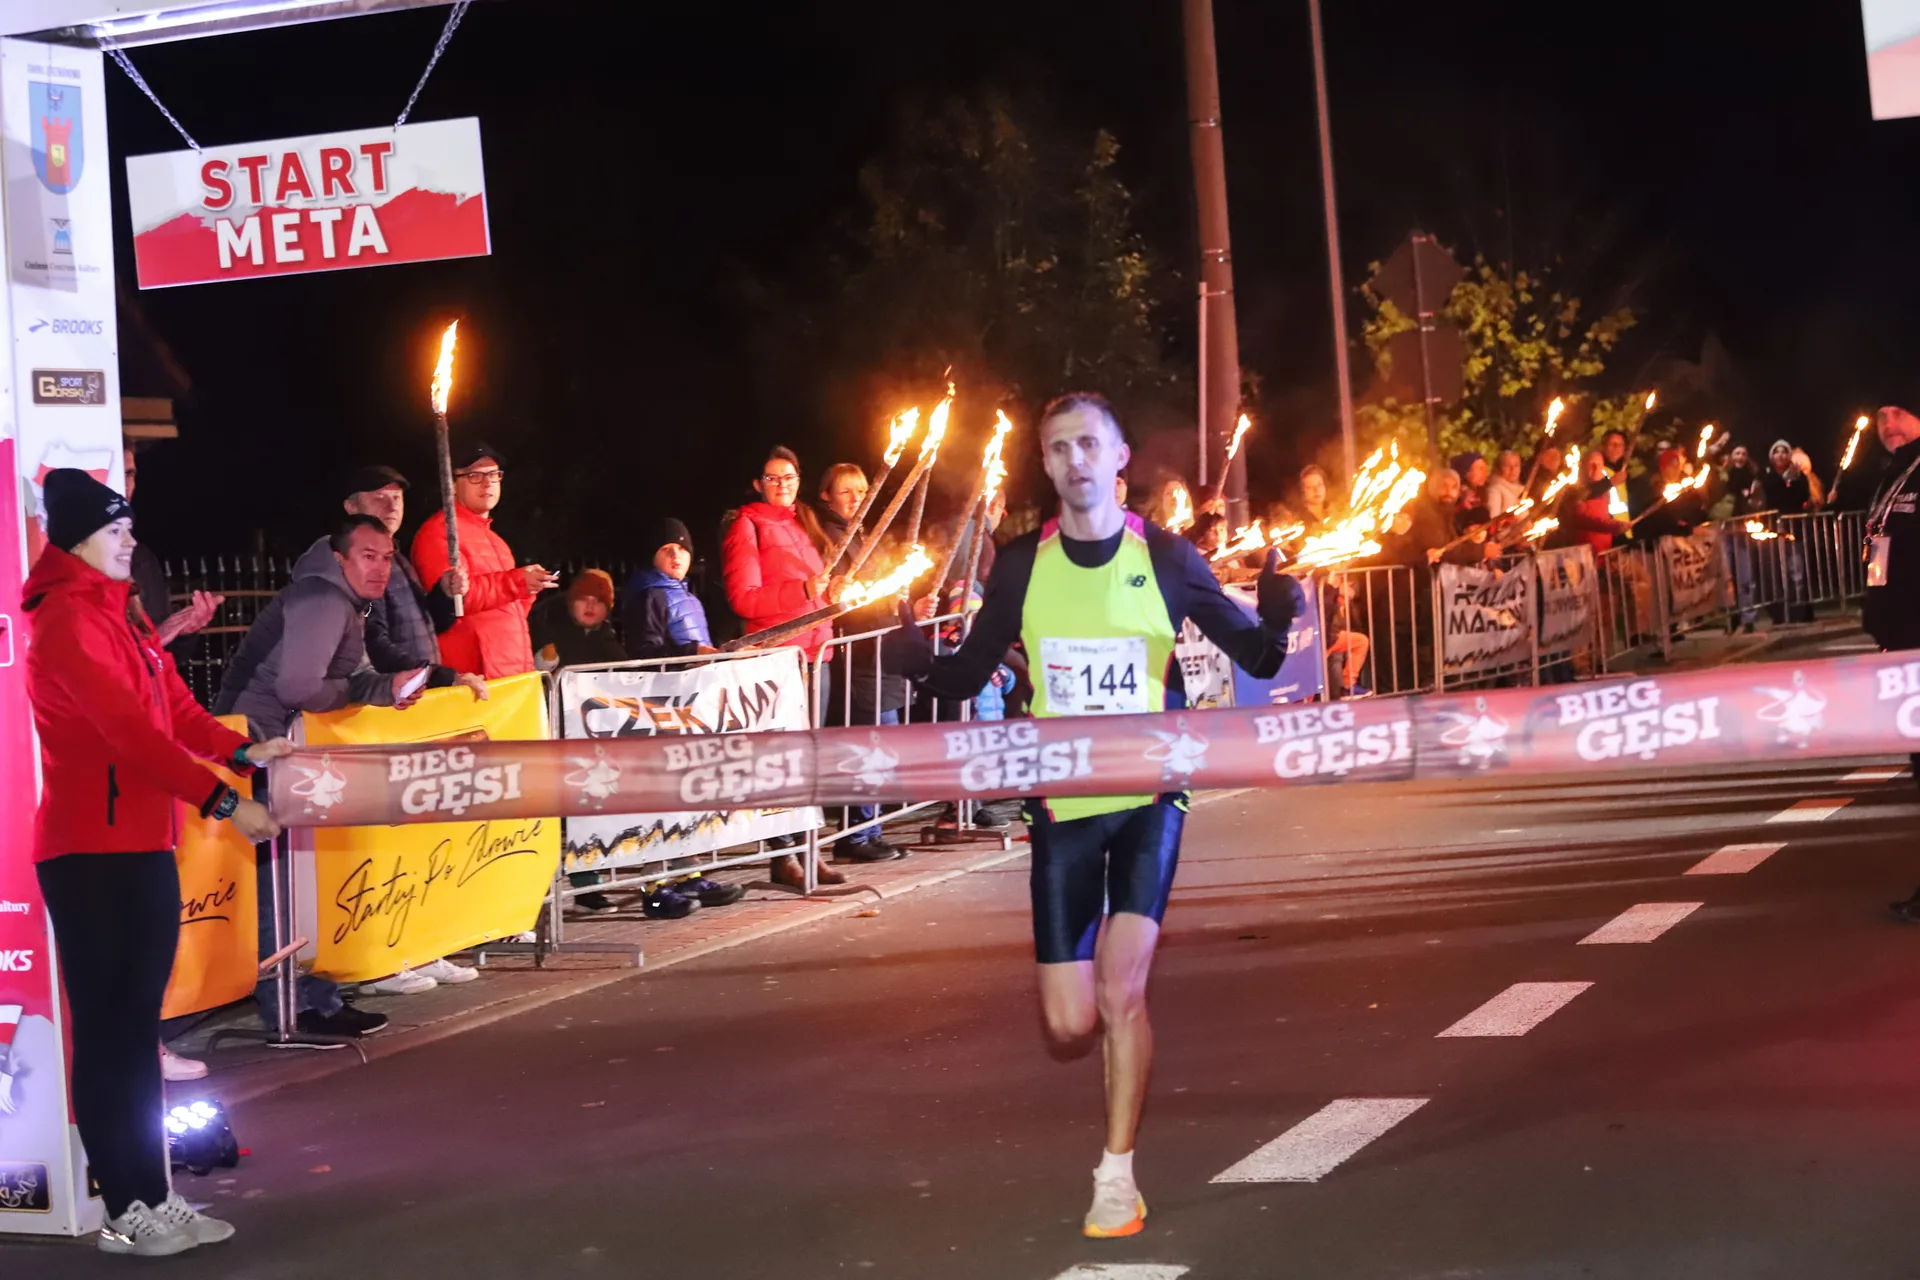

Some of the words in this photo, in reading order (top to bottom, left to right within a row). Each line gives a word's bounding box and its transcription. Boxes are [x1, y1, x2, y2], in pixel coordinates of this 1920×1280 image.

[200, 141, 394, 210] START
[215, 205, 388, 269] META
[52, 318, 103, 335] BROOKS
[60, 377, 83, 387] SPORT
[1080, 663, 1137, 696] 144
[1254, 702, 1354, 744] BIEG
[1556, 680, 1661, 725] BIEG
[944, 721, 1039, 760] BIEG
[1273, 720, 1413, 779] GĘSI
[1576, 697, 1720, 761] GĘSI
[389, 747, 476, 783] BIEG
[663, 735, 754, 771] BIEG
[960, 737, 1093, 792] GĘSI
[401, 763, 522, 815] GĘSI
[680, 749, 804, 803] GĘSI
